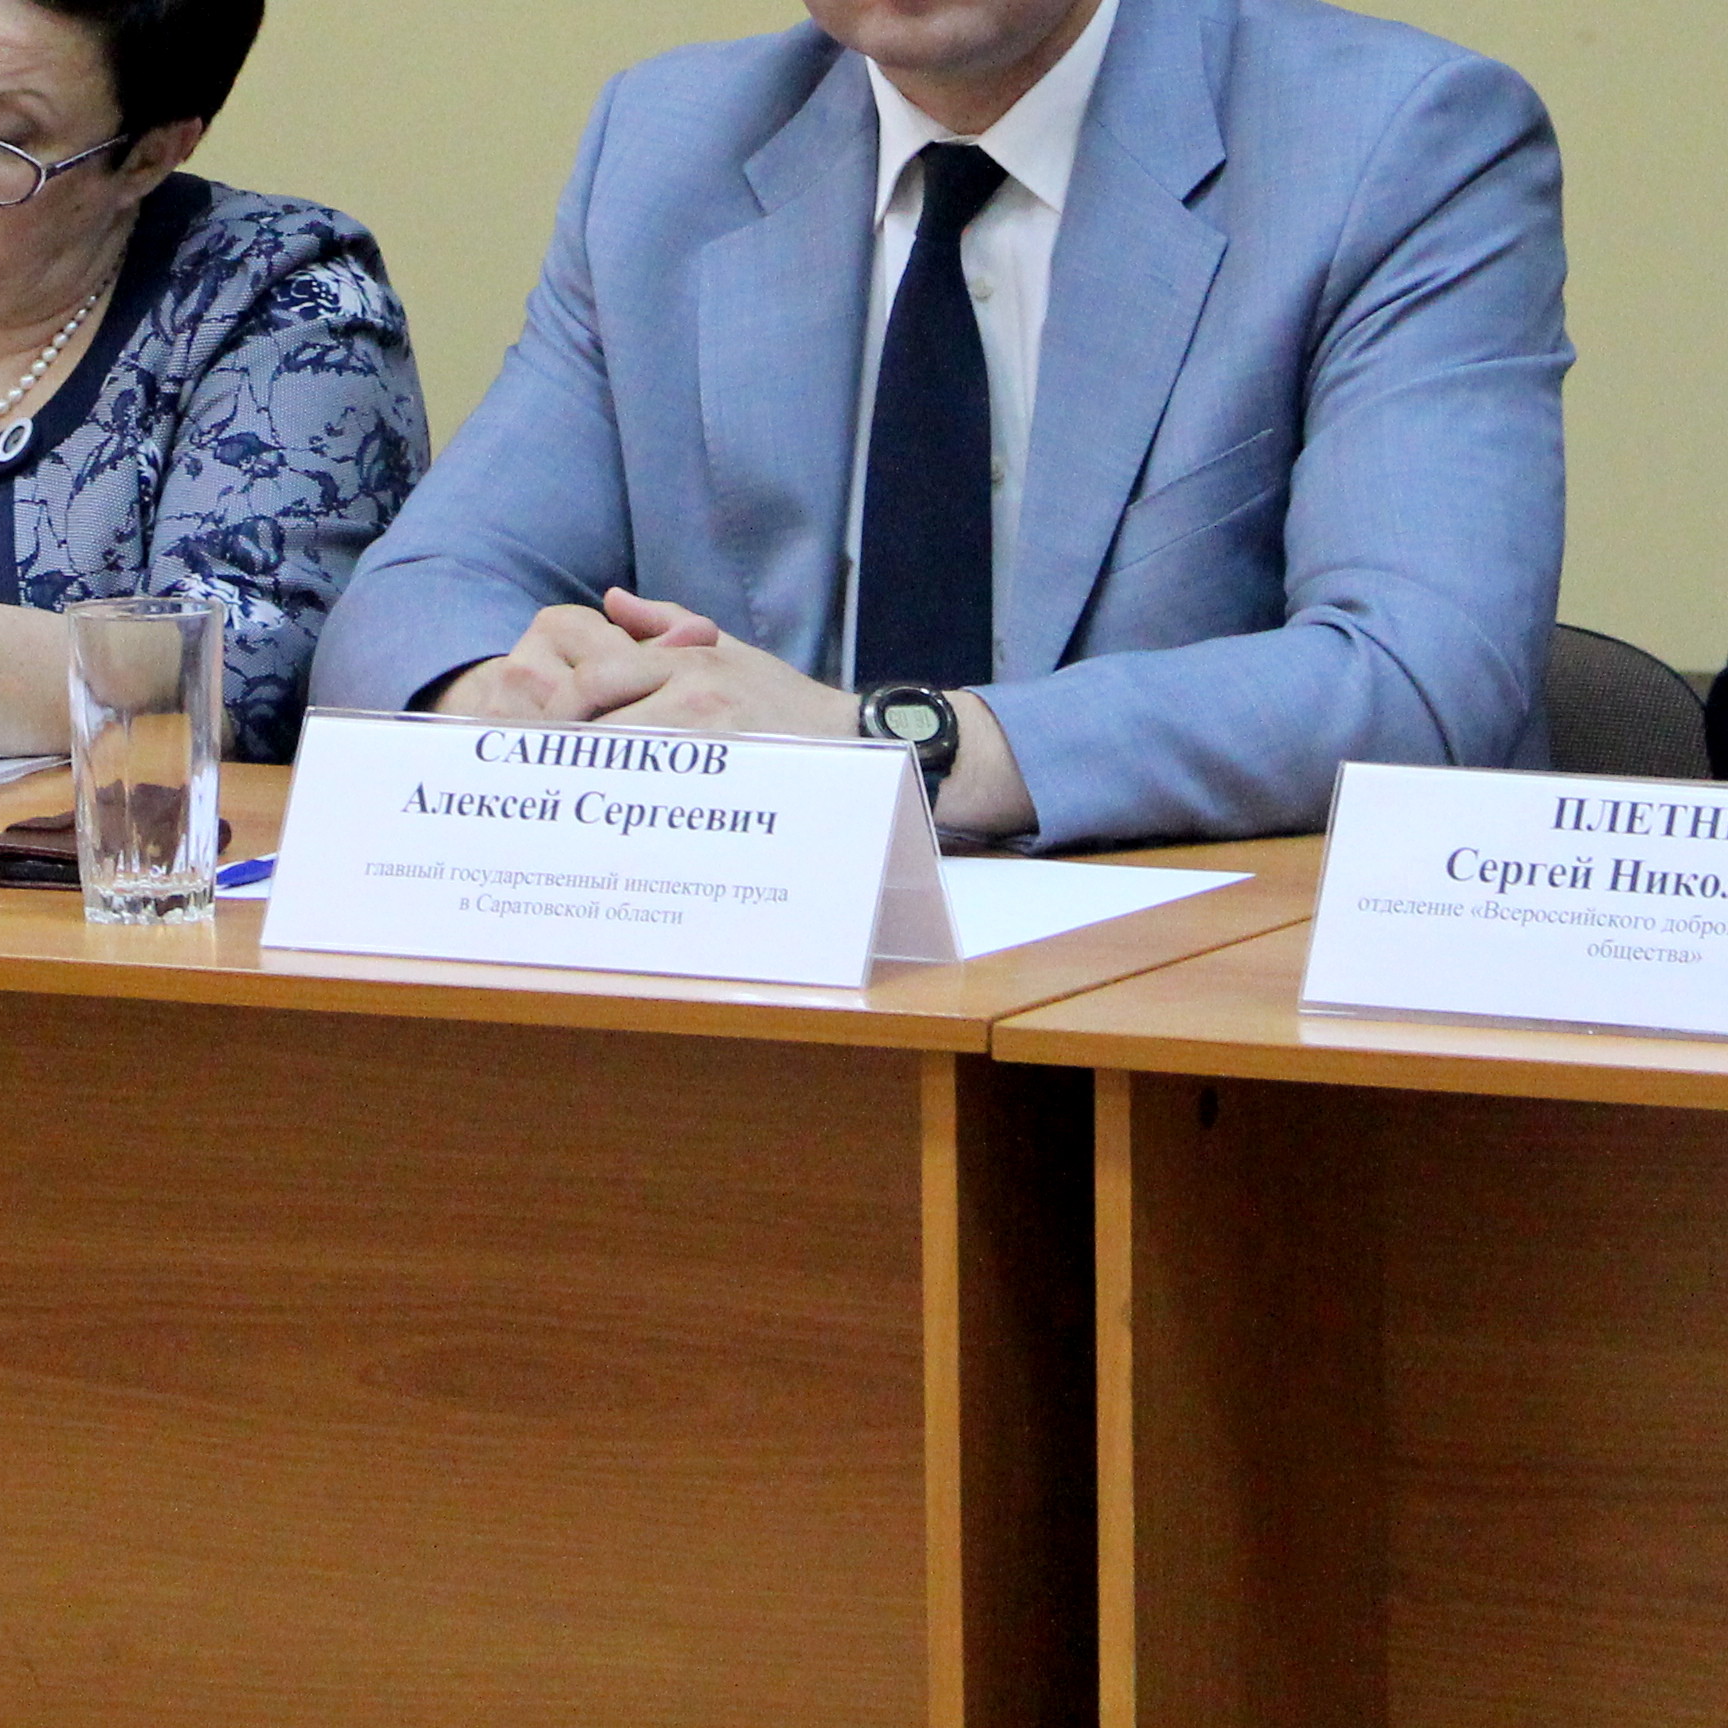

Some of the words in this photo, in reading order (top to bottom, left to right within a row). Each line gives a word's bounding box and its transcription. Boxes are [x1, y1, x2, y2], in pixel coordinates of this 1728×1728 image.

[475, 729, 729, 775] САННИКОВ
[401, 781, 562, 822] Алексей
[574, 791, 778, 836] Сергеевич
[365, 862, 445, 879] главный
[450, 867, 618, 890] государственный
[624, 878, 726, 902] инспектор
[733, 885, 788, 904] труда
[1445, 847, 1595, 895] Сергей
[459, 898, 470, 910] в
[476, 894, 599, 919] Саратовской
[605, 902, 684, 925] области
[1358, 898, 1464, 917] отделение
[1471, 900, 1656, 930] «Всероссийского
[1586, 939, 1703, 963] общества»
